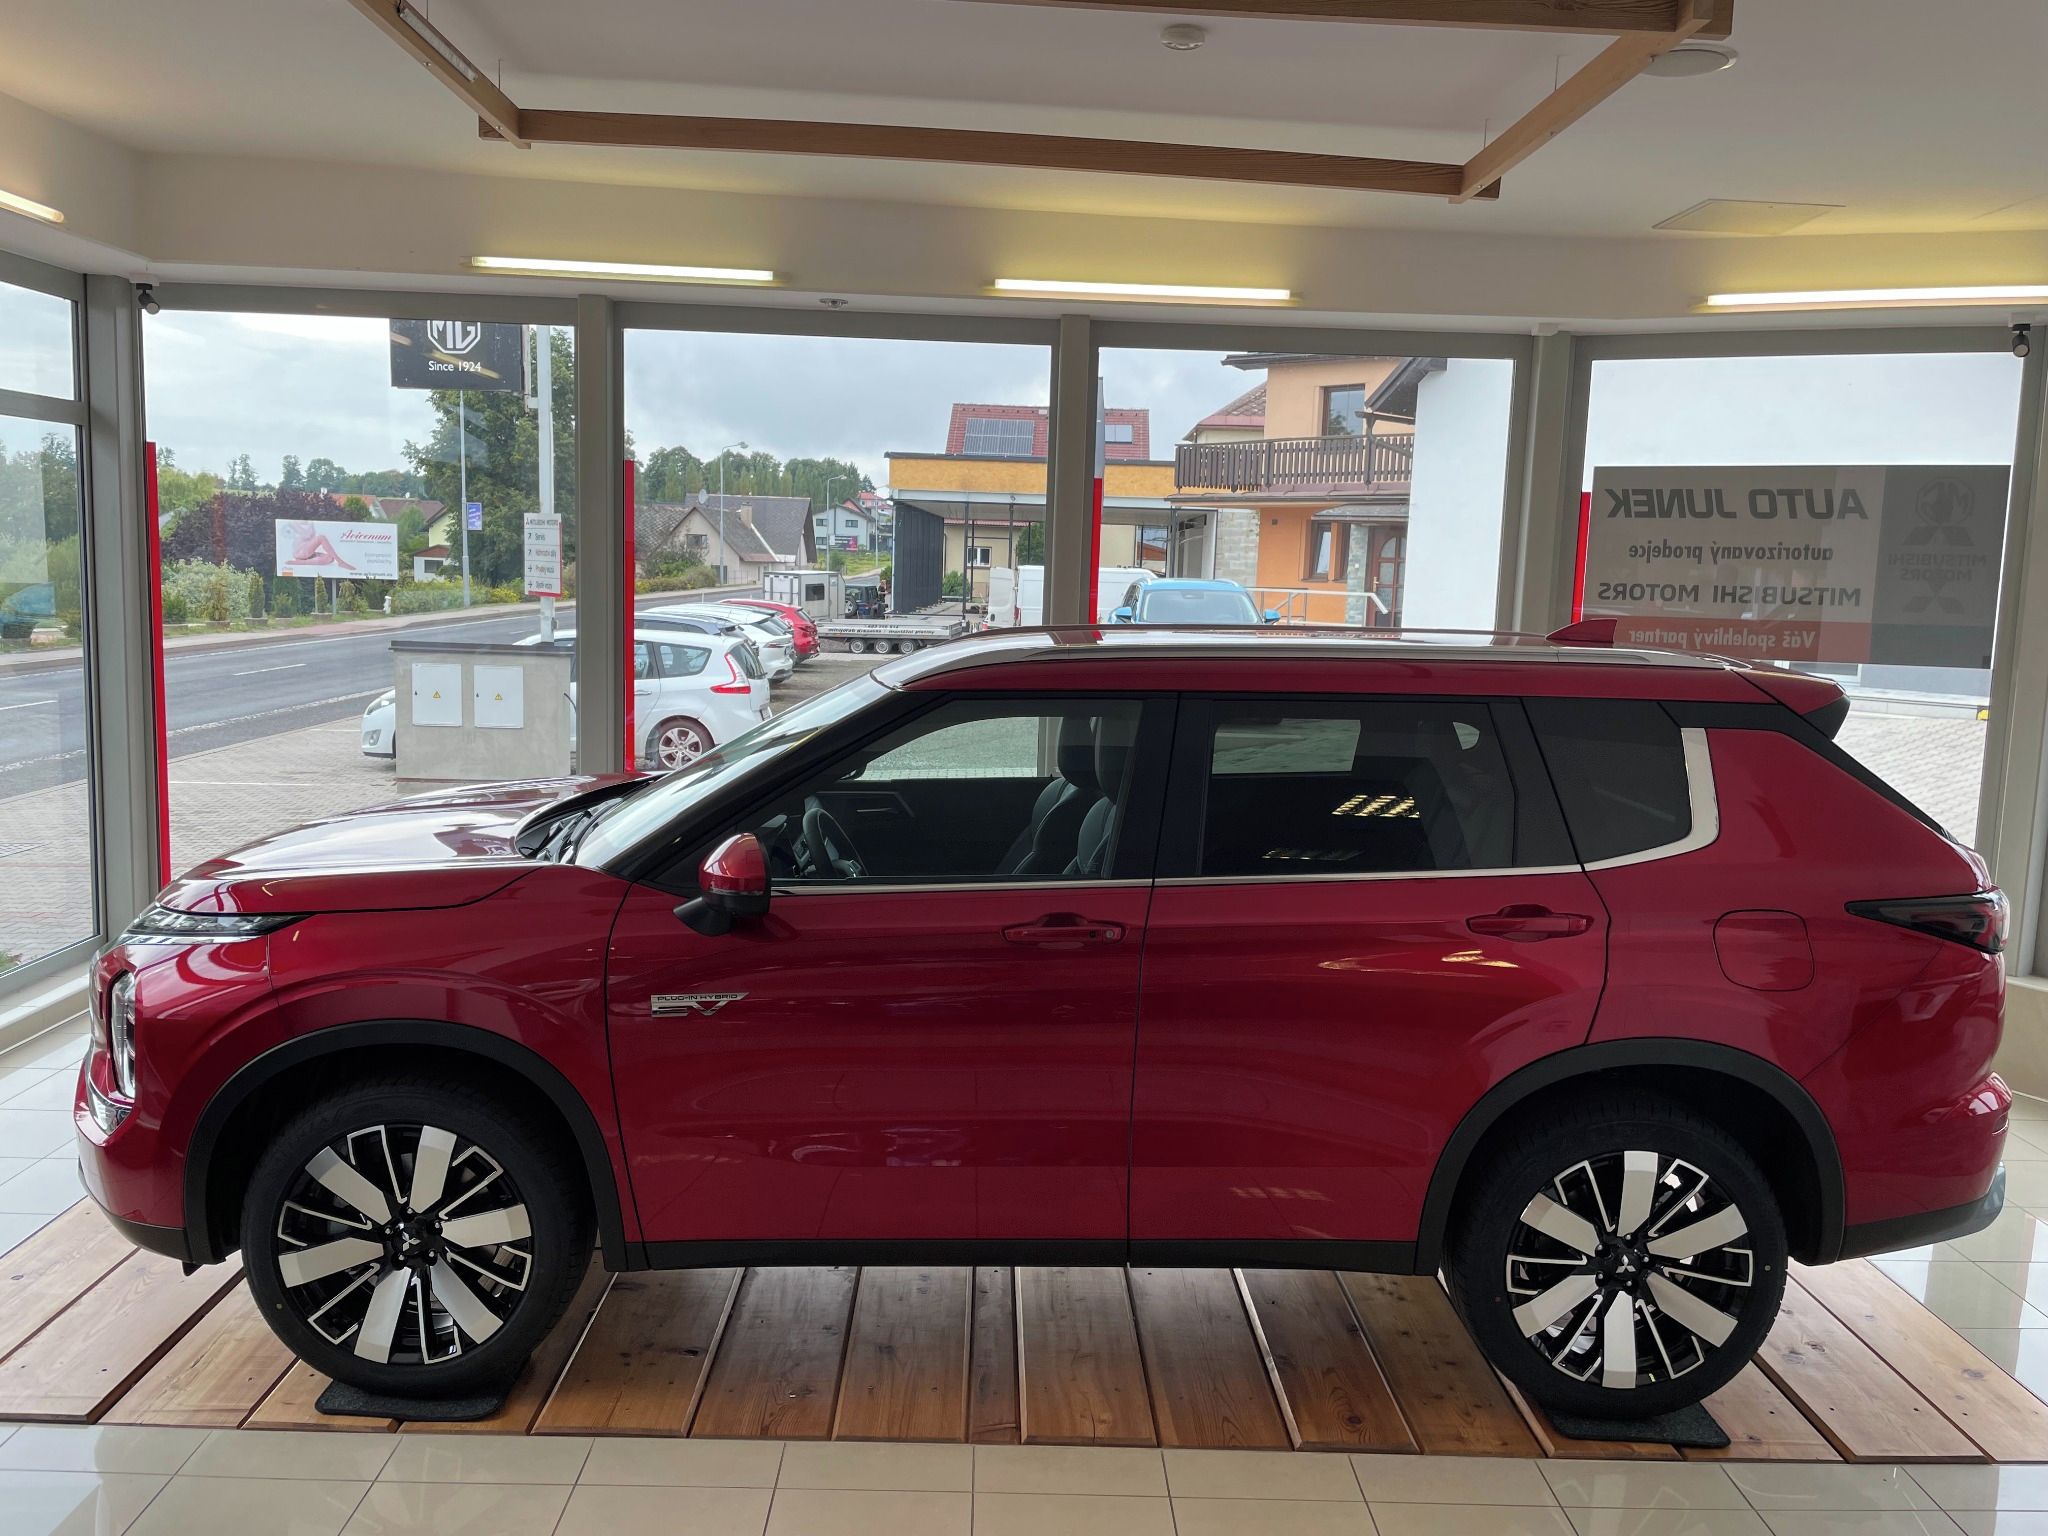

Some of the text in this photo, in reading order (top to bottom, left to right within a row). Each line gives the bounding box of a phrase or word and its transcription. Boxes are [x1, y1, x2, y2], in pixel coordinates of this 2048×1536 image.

[430, 320, 478, 349] MG
[428, 360, 481, 372] Since 1924
